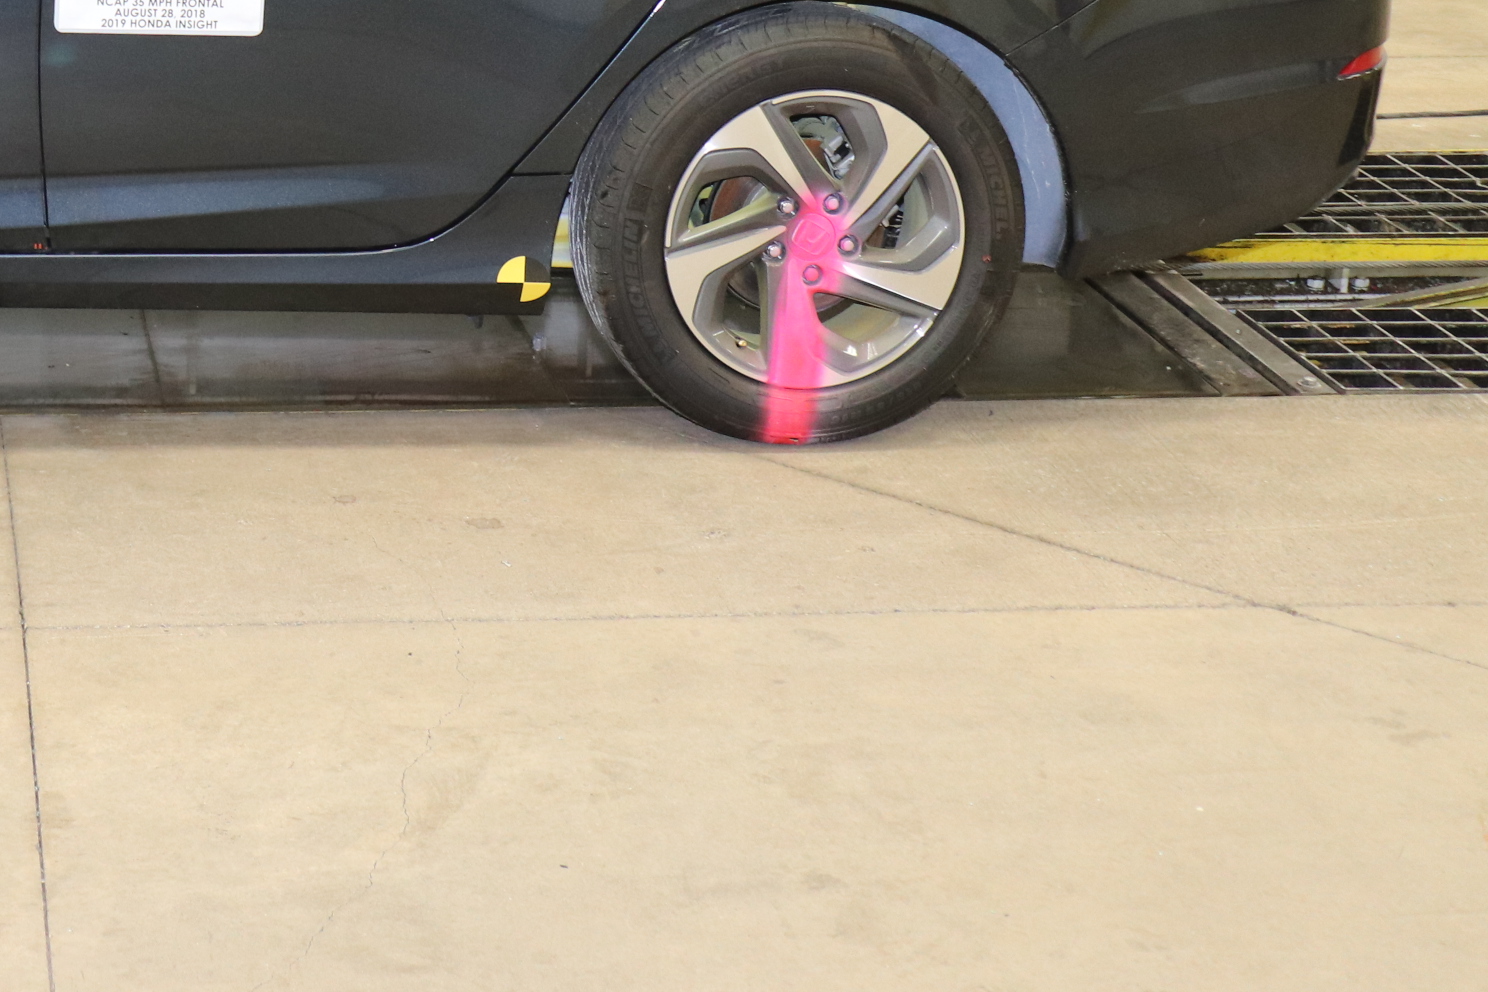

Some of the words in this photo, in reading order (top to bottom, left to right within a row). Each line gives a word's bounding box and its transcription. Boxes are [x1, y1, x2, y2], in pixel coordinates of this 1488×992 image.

[176, 0, 224, 8] FRONTAL
[115, 9, 158, 17] AUGUST
[161, 9, 176, 19] 28,
[180, 9, 206, 18] 2018
[101, 19, 126, 28] 2019
[130, 19, 171, 28] HONDA
[175, 20, 218, 29] INSIGHT
